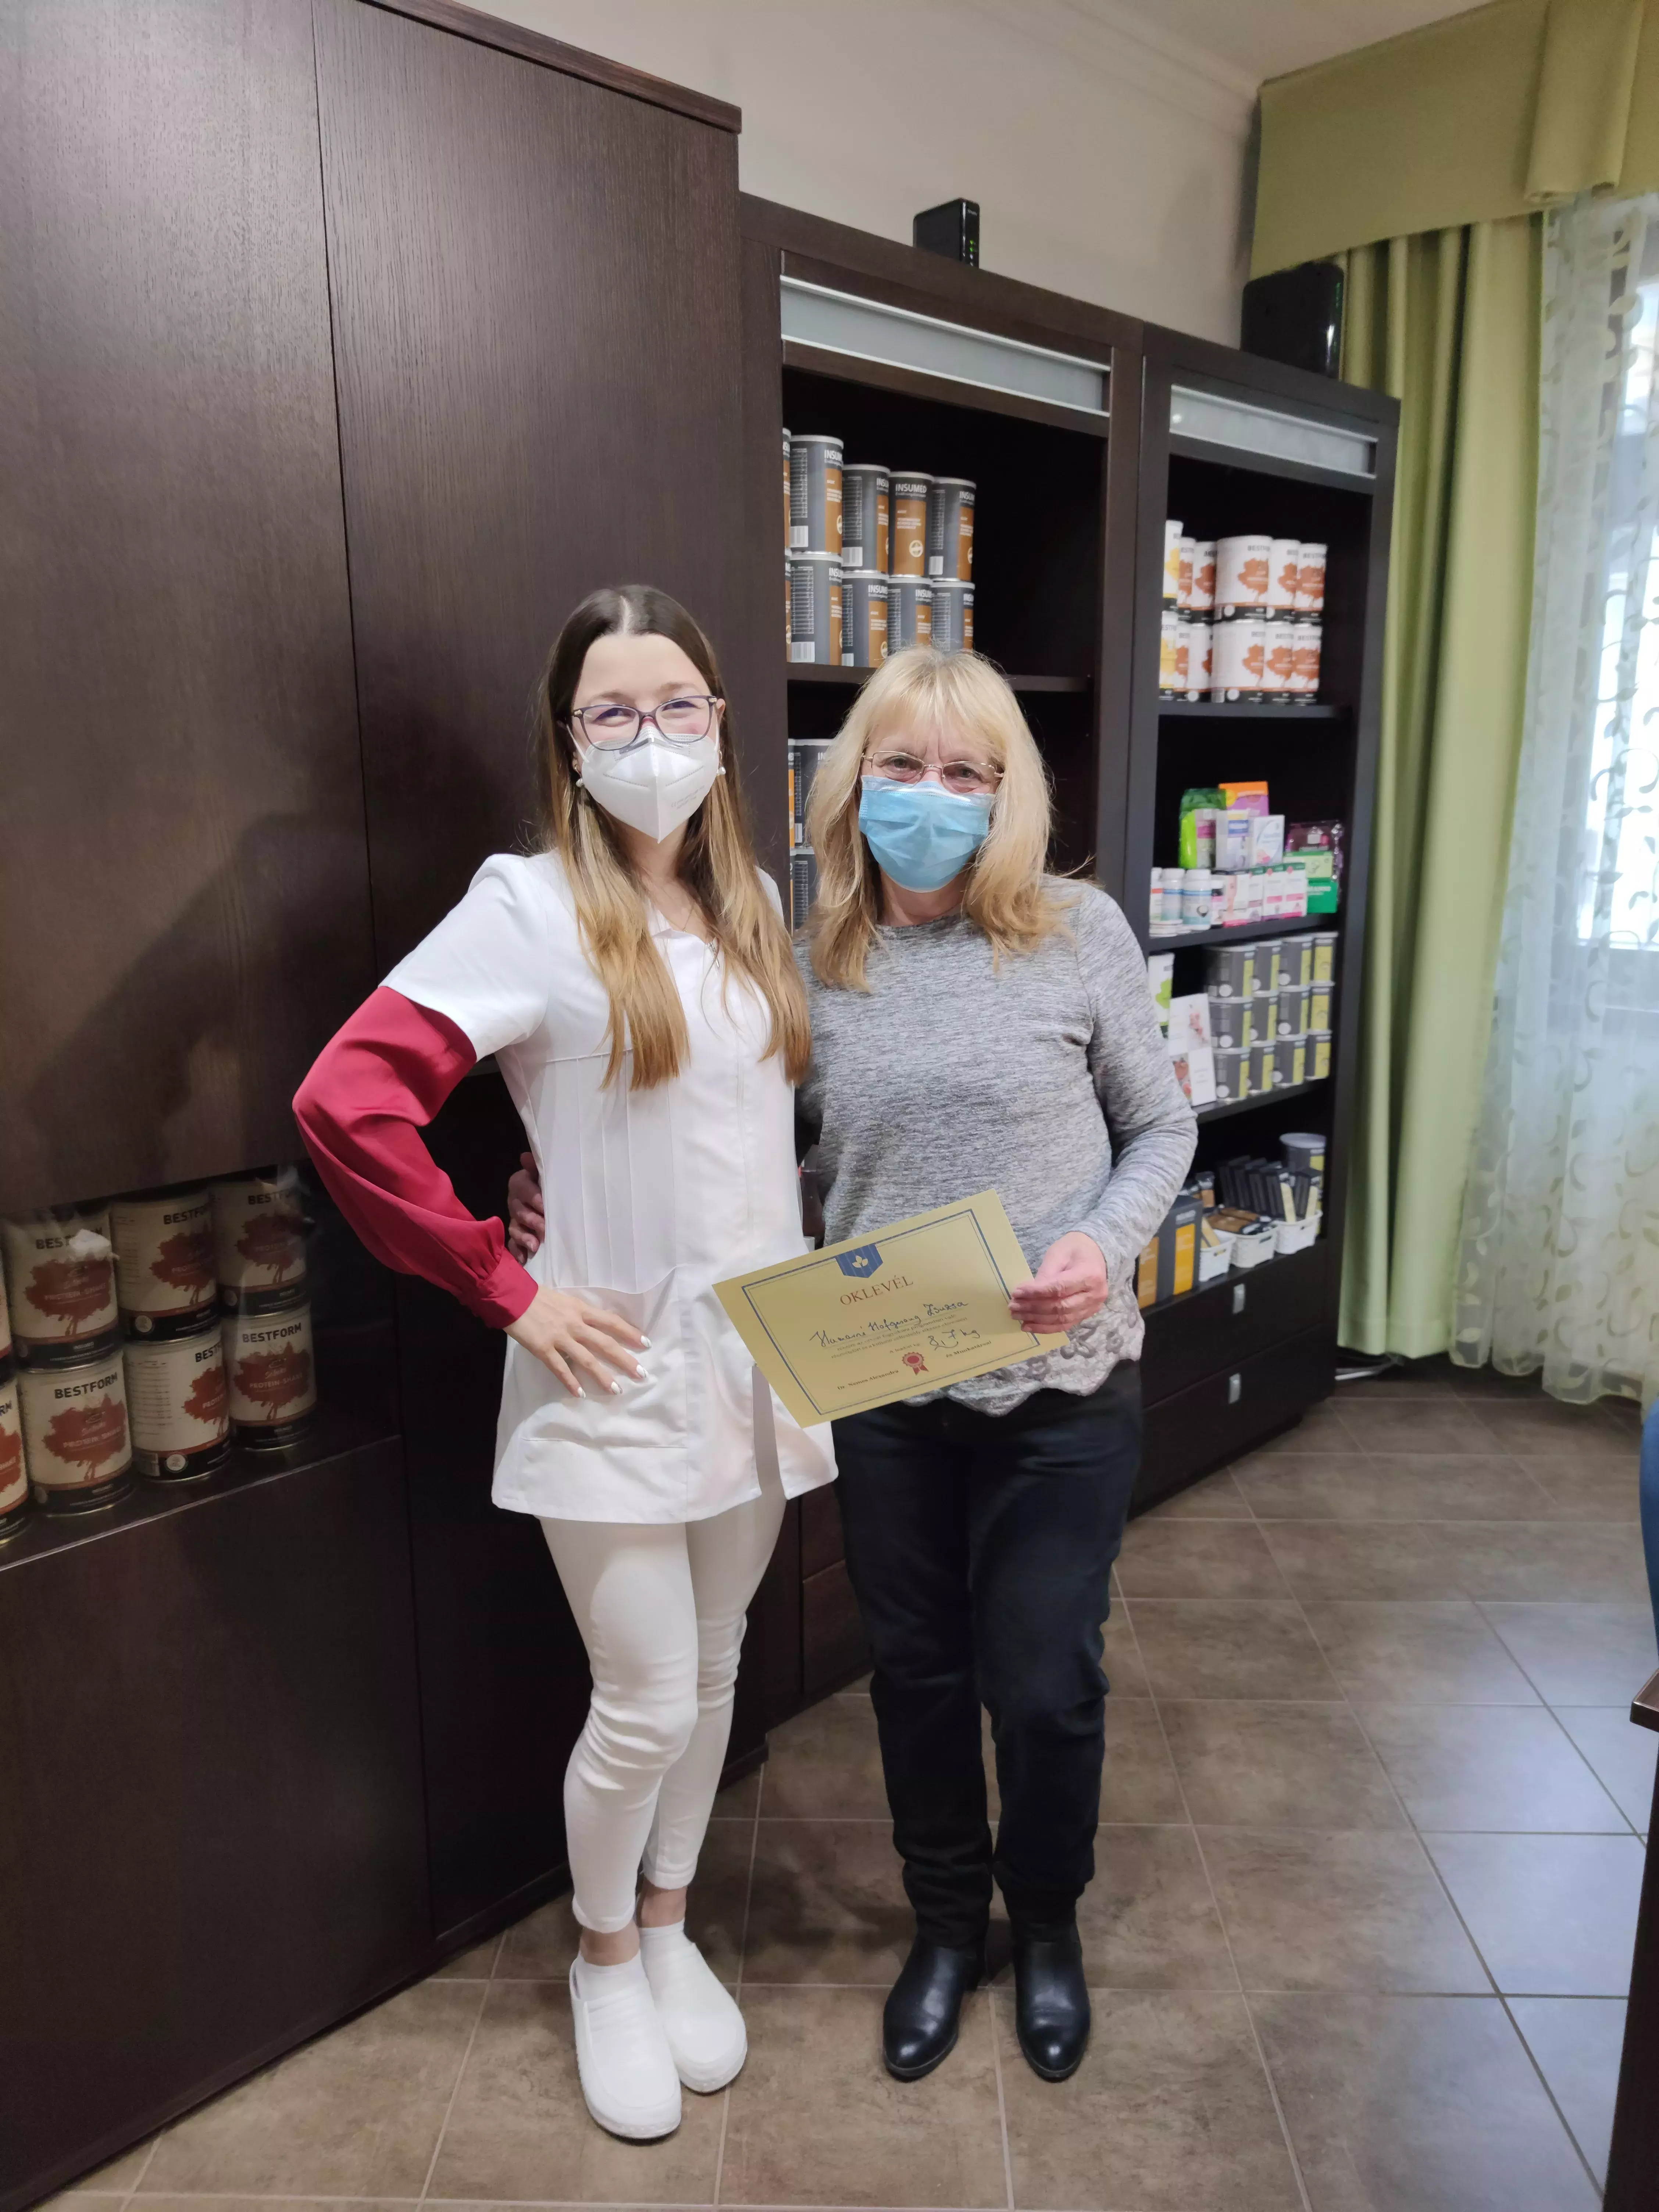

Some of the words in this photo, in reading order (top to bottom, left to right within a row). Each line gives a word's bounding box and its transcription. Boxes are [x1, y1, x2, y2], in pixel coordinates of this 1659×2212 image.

[895, 484, 927, 493] INSUMED
[840, 1275, 913, 1305] OKLEVÉL
[242, 1323, 302, 1343] BESTFORM
[54, 1372, 118, 1399] BESTFORM
